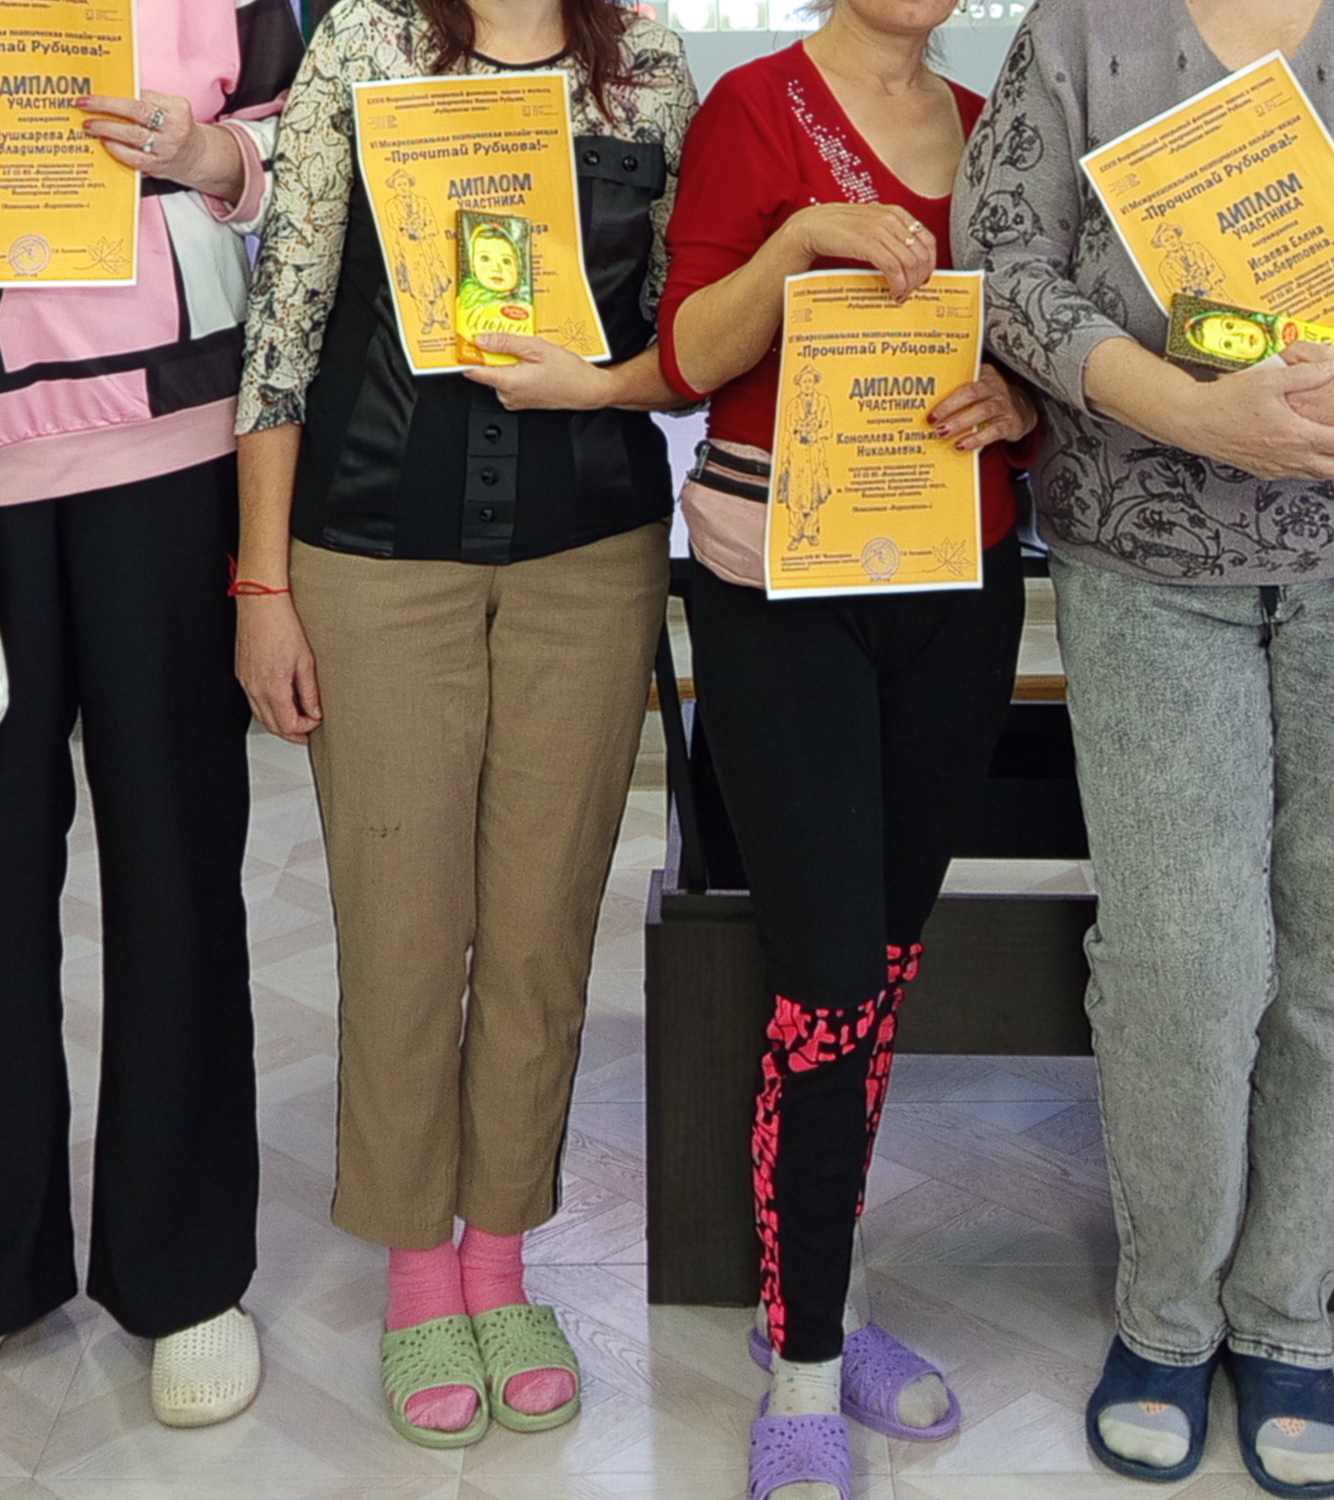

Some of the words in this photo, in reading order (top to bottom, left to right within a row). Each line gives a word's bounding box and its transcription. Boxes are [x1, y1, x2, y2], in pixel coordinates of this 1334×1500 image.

[7, 98, 74, 109] УЧАСТНИК
[448, 173, 532, 200] ДИПЛОМ
[457, 194, 525, 210] УЧАСТНИКА
[1216, 173, 1303, 234] ДИПЛОМ
[1229, 197, 1304, 240] УЧАСТНИКА
[1247, 245, 1290, 271] Исаева
[1289, 226, 1324, 248] Елена
[849, 377, 935, 399] ДИПЛОМ
[858, 398, 926, 412] УЧАСТНИКА
[837, 433, 894, 444] Коноплева
